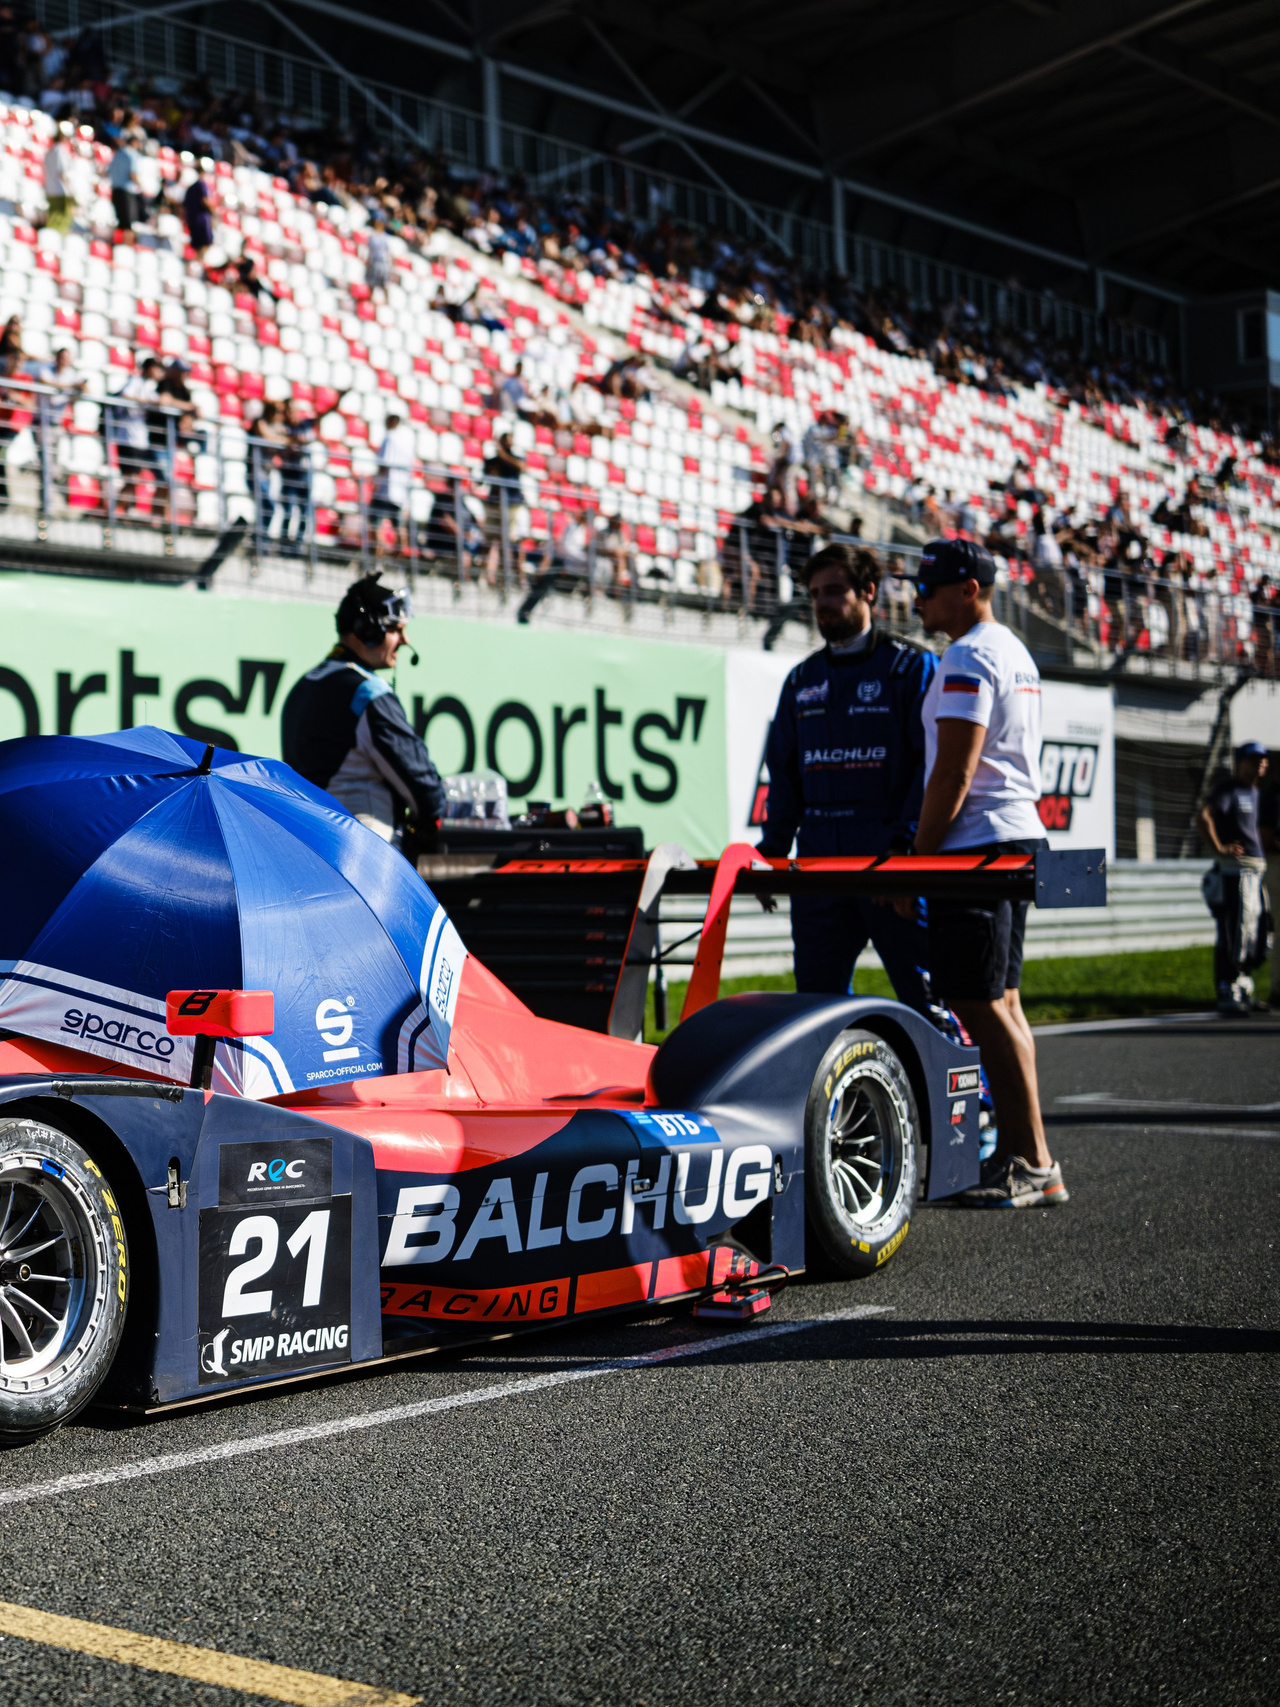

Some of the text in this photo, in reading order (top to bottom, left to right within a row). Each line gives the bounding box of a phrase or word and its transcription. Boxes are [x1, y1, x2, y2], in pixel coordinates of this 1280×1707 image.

[412, 686, 707, 804] ports"
[1040, 742, 1097, 796] ВТО
[60, 1008, 175, 1063] sparco
[650, 1113, 701, 1137] ВТБ
[83, 1159, 128, 1304] P ZERO
[381, 1144, 773, 1268] BALCHUG
[221, 1209, 331, 1318] 21
[230, 1324, 349, 1364] SMP RACING
